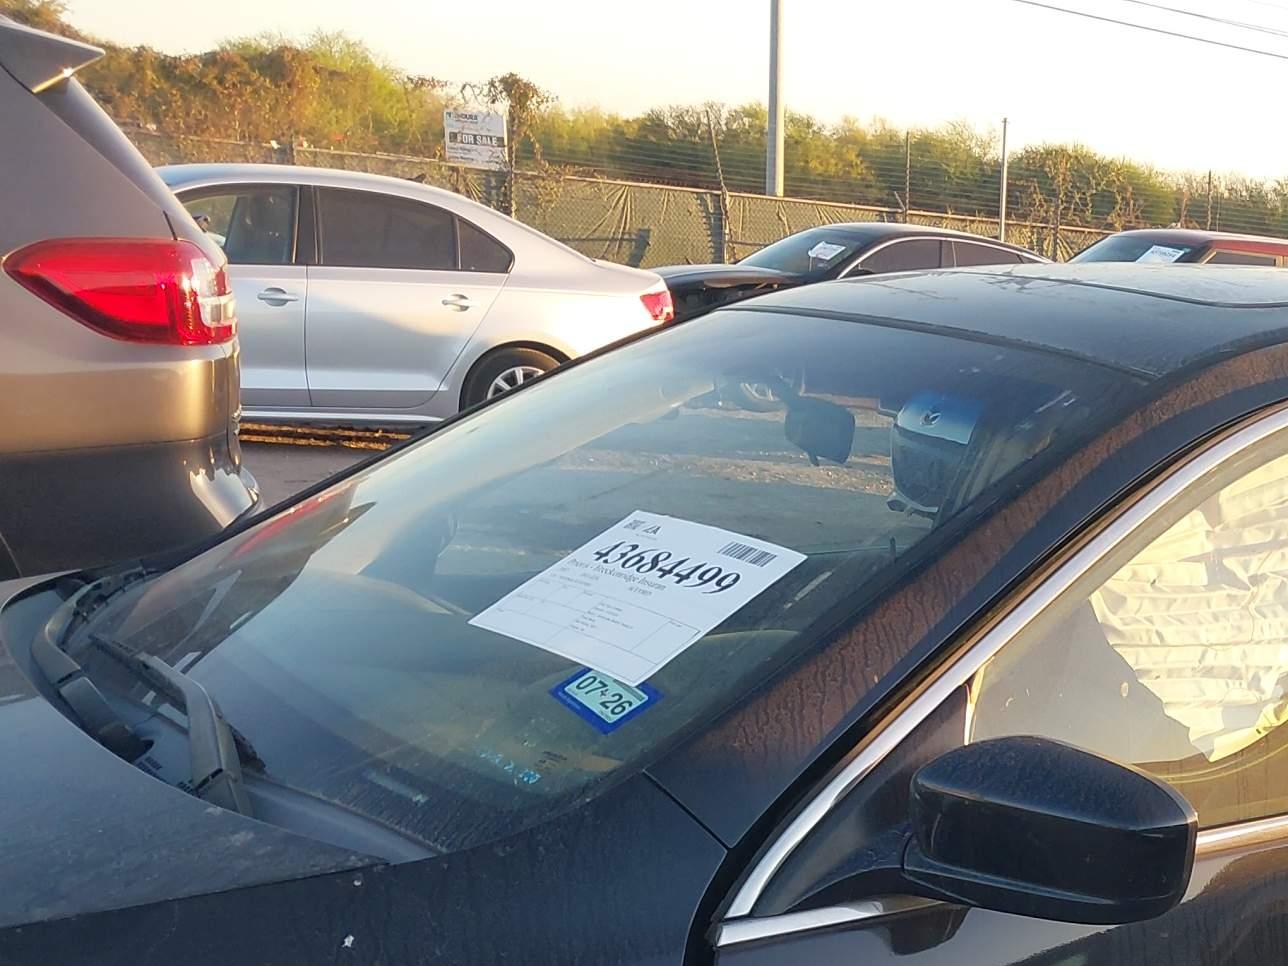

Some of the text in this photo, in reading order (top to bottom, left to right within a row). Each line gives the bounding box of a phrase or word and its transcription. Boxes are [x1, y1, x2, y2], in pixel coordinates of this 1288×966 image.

[457, 132, 498, 146] FOR SALE
[593, 541, 741, 594] 43684499
[576, 676, 608, 694] 07
[600, 693, 632, 715] 26
